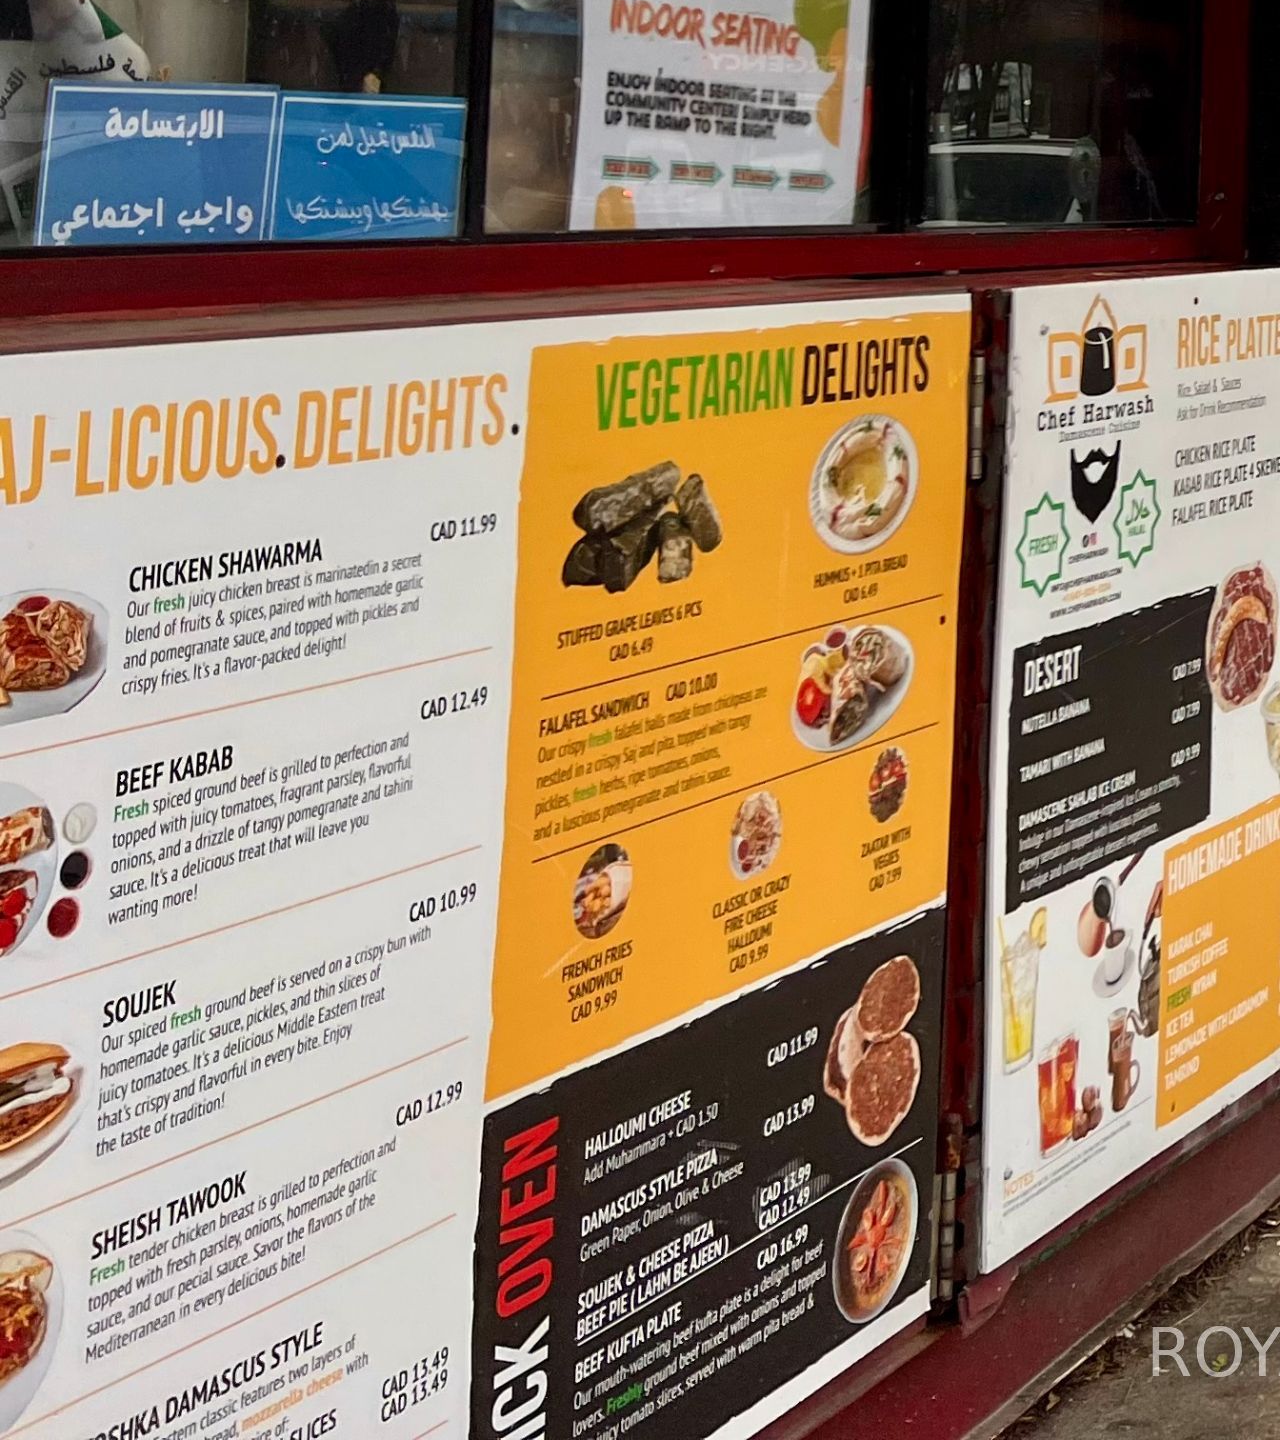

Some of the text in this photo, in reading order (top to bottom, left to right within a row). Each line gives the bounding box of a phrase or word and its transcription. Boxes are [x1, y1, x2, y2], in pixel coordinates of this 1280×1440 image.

[712, 11, 799, 57] SEATING
[606, 91, 686, 113] COMMUNITY
[743, 105, 779, 123] SIMPLY
[607, 70, 651, 91] ENJOY
[709, 83, 757, 103] SEATING
[105, 108, 224, 146] الابتسامة
[604, 110, 622, 125] UP
[626, 112, 650, 129] THE
[655, 113, 690, 132] RAMP
[695, 118, 711, 133] TO
[715, 120, 736, 136] THE
[52, 196, 254, 245] واجب اجتماعي
[1177, 314, 1221, 369] RICE
[596, 335, 930, 431] VEGETARIAN DELIGHTS
[1037, 395, 1155, 433] Chef Harwash
[1175, 443, 1211, 468] CHICKEN
[1212, 440, 1231, 461] RICE
[1232, 435, 1256, 456] PLATE
[1174, 474, 1202, 497] KABAB
[1203, 468, 1222, 491] RICE
[1224, 463, 1248, 486] PLATE
[129, 514, 497, 593] CHICKEN SHAWARMA CAD 11.99
[1027, 533, 1058, 558] FRESH
[127, 599, 150, 619] Our
[153, 594, 185, 614] fresh
[188, 590, 216, 615] juicy
[218, 581, 263, 604] chicken
[265, 576, 301, 596] breast
[390, 554, 422, 572] secret
[557, 625, 602, 649] STUFFED
[605, 618, 638, 641] GRAPE
[639, 610, 675, 633] LEAVES
[684, 601, 703, 618] PCS
[1023, 644, 1083, 697] DESERT
[539, 691, 649, 738] FALAFEL SANDWICH
[115, 687, 488, 797] BEEF KABAB CAD 12.49
[1168, 827, 1243, 895] HOMEMADE
[713, 893, 748, 920] CLASSIC
[763, 875, 791, 898] CRAZY
[724, 900, 778, 936] FIRE CHEESE
[102, 883, 477, 1027] SOUJEK CAD 10.99
[561, 940, 633, 983] FRENCH FRIES
[568, 967, 624, 1003] SANDWICH
[571, 990, 618, 1023] CAD 9.99
[584, 1090, 816, 1160] HALLOUMI CHEESE CAD 13.99
[91, 1081, 464, 1260] SHEISH TAWOOK CAD 12.99
[581, 1148, 719, 1238] DAMASCUS STYLE PIZZA
[497, 1115, 561, 1319] OVEN
[575, 1224, 810, 1384] BEEF KUFTA PLATE CAD 16.99
[165, 1321, 450, 1422] DAMASCUS STYLE CAD 13.49
